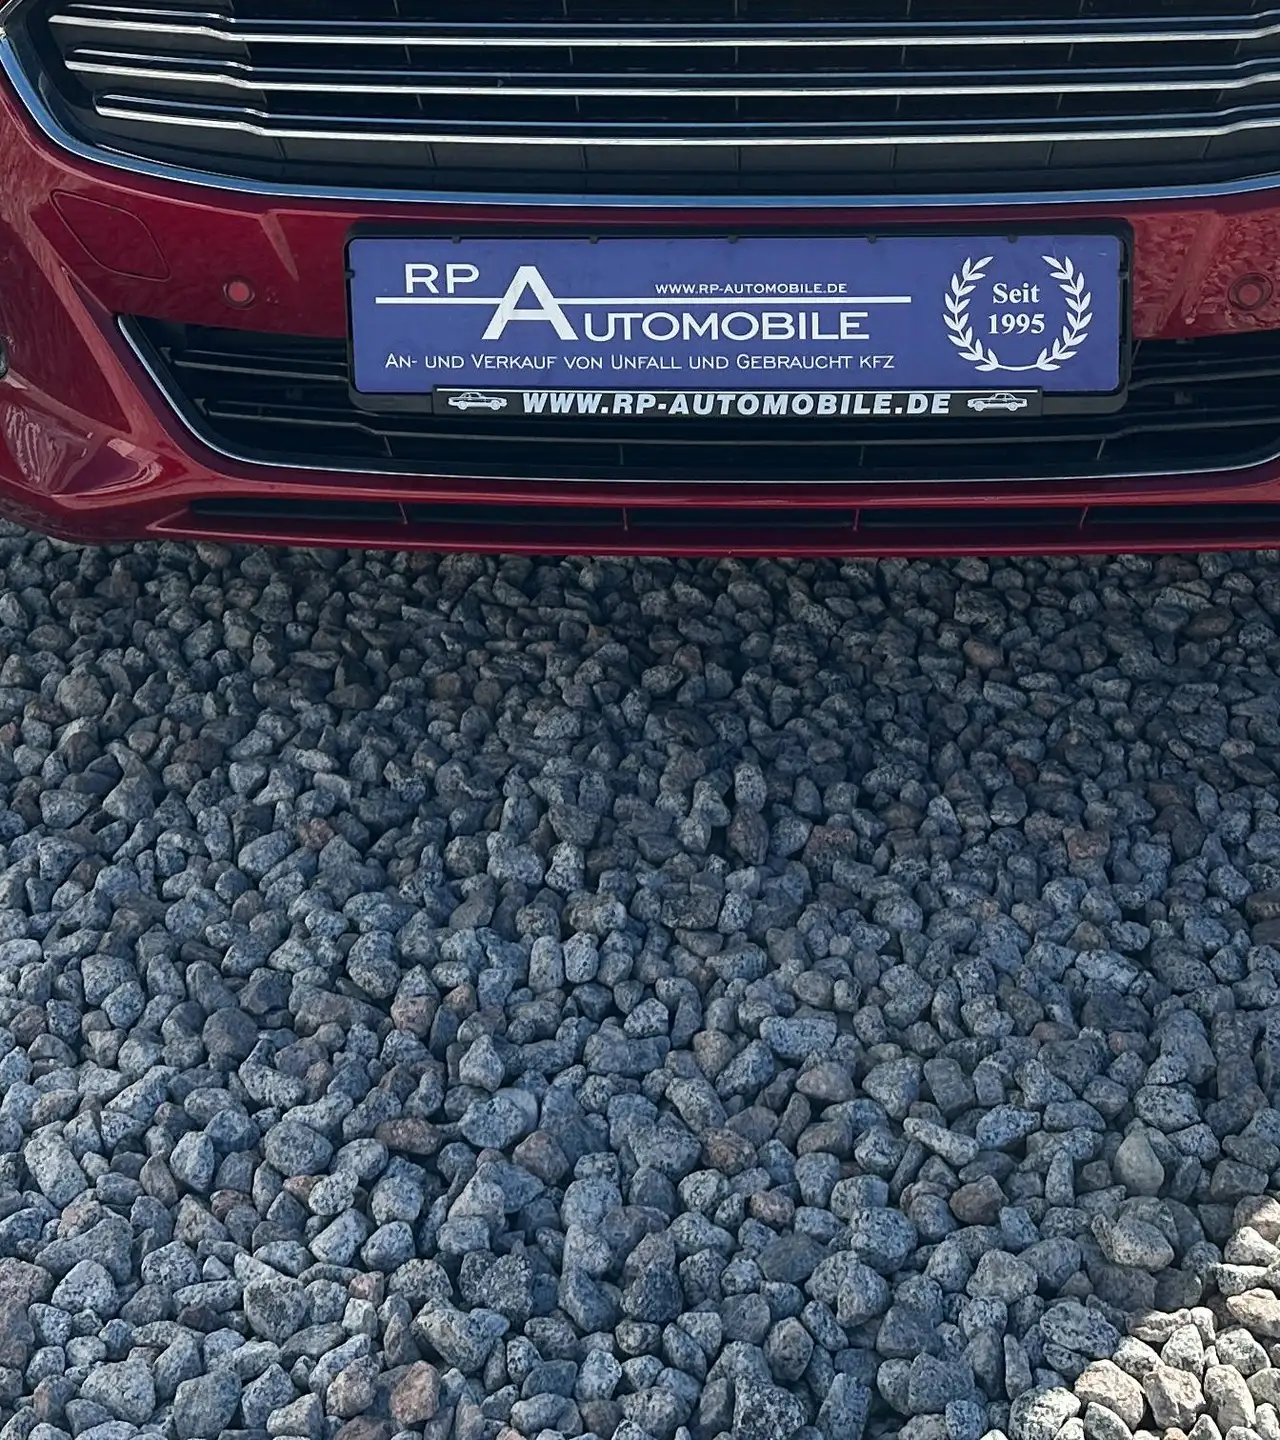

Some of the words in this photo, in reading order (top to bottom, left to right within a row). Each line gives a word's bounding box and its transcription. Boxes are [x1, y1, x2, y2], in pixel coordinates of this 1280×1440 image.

[655, 283, 848, 295] WWW.RP-AUTOMOBILE.DE
[992, 282, 1040, 304] Seit
[404, 263, 480, 294] RP
[482, 265, 870, 342] AUTOMOBILE
[987, 313, 1045, 335] 1995
[425, 356, 464, 369] UND
[471, 353, 558, 369] VERKAUF
[563, 356, 603, 369] VON
[611, 354, 682, 369] UNFALL
[689, 356, 729, 370] UND
[737, 354, 853, 369] GEBRAUCHT
[860, 355, 895, 369] KFZ
[522, 392, 951, 415] WWW.RP-AUTOMOBILE.DE
